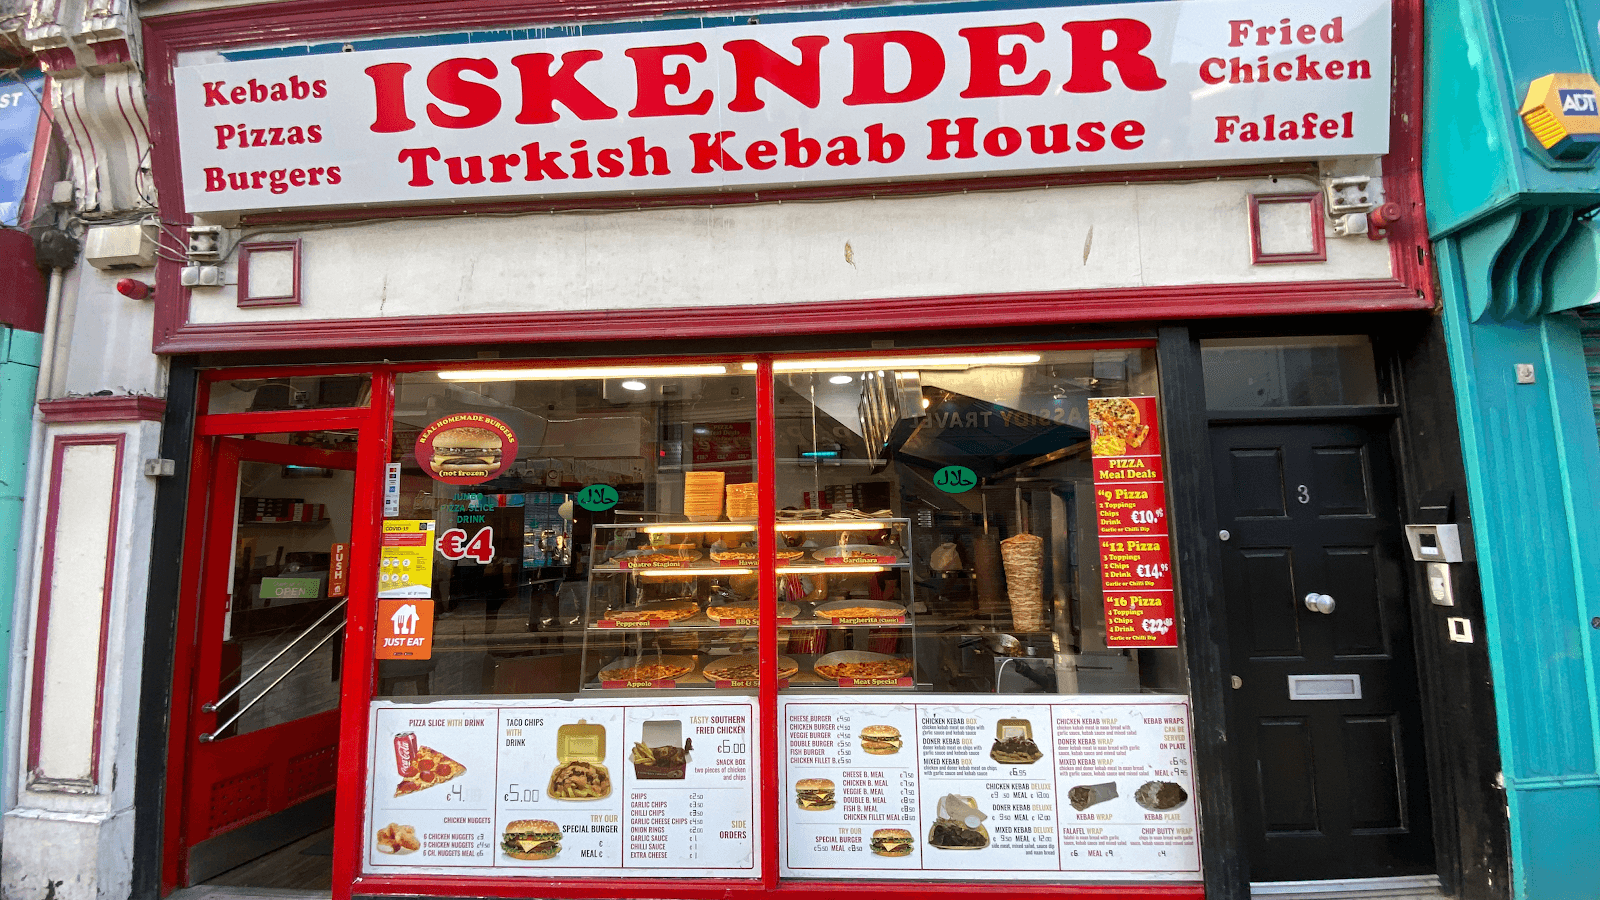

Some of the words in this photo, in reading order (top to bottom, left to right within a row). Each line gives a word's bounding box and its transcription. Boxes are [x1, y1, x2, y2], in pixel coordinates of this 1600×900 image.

[1228, 16, 1344, 48] Fried
[365, 18, 1166, 133] ISKENDER
[1198, 53, 1372, 86] Chicken
[203, 75, 328, 107] Kebabs
[1562, 94, 1596, 112] ADT
[214, 120, 323, 149] Pizzas
[1215, 111, 1354, 145] Falafel
[398, 137, 671, 187] Turkish
[691, 128, 905, 173] Kebab
[927, 116, 1146, 161] House
[204, 161, 342, 196] Burgers
[420, 426, 437, 444] REAL
[437, 415, 484, 430] HOMEMADE
[485, 417, 515, 444] BURGERS
[1109, 459, 1144, 468] PIZZA
[937, 469, 973, 486] حلال
[1099, 470, 1124, 479] Meal
[1127, 469, 1156, 478] Deals
[581, 488, 616, 505] حلال
[1115, 489, 1148, 499] Pizza
[1298, 484, 1310, 504] 3
[469, 504, 494, 512] SLICE
[457, 515, 485, 524] DRINK
[436, 526, 495, 564] €4
[1127, 541, 1160, 551] Pizza
[275, 587, 306, 596] OPEN
[1130, 596, 1162, 606] Pizza
[383, 638, 406, 647] JUST
[407, 638, 425, 646] EAT
